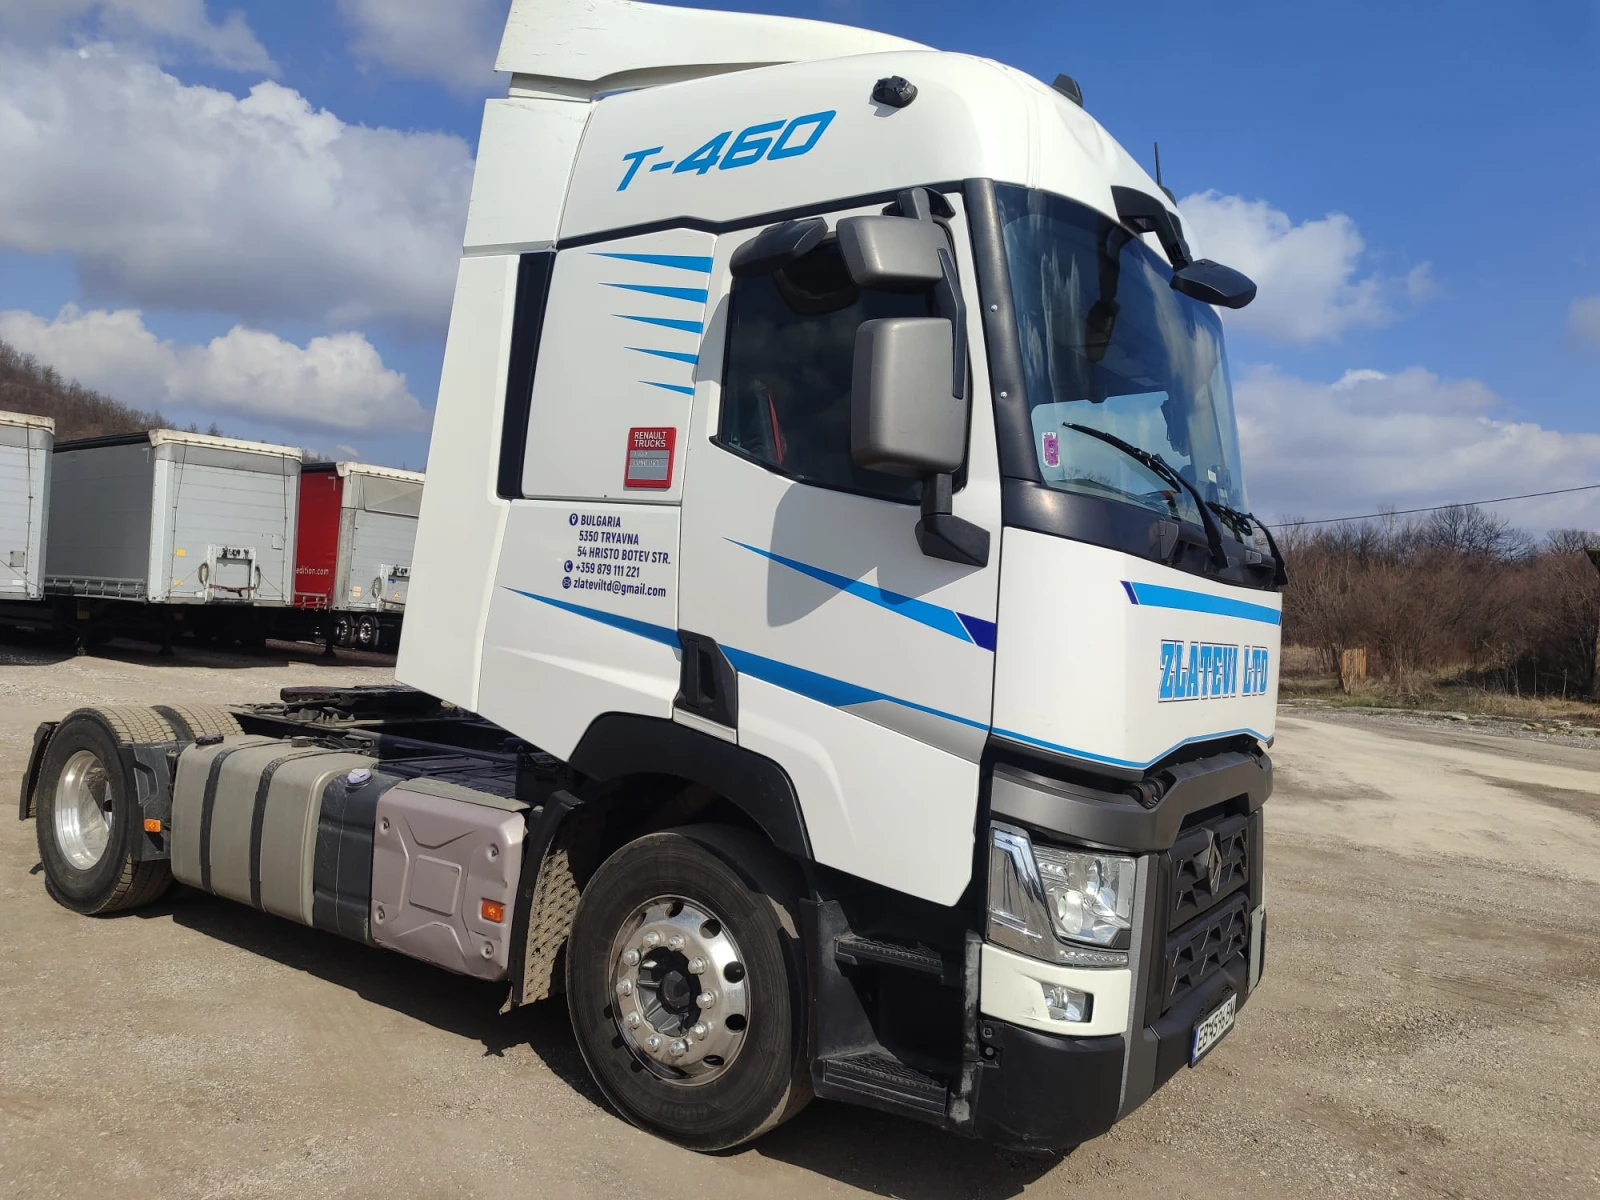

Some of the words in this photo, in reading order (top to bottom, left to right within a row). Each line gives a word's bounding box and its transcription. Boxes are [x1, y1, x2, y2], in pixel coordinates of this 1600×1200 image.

[616, 109, 837, 192] T-460
[634, 432, 667, 440] RENAULT
[634, 439, 666, 448] TRUCKS
[581, 515, 621, 528] BULGARIA
[579, 530, 599, 543] 5350
[600, 531, 639, 546] TRYAVNA
[577, 546, 587, 558] 54
[589, 547, 619, 560] HRISTO
[622, 549, 650, 563] BOTEV
[651, 551, 671, 565] STR.
[575, 562, 595, 575] +359
[597, 563, 612, 576] 879
[613, 564, 624, 577] 111
[626, 566, 640, 578] 221
[573, 577, 666, 597] zlateviltd@gmail.com
[1158, 639, 1239, 703] ZLATEVI
[1242, 645, 1268, 696] LTD
